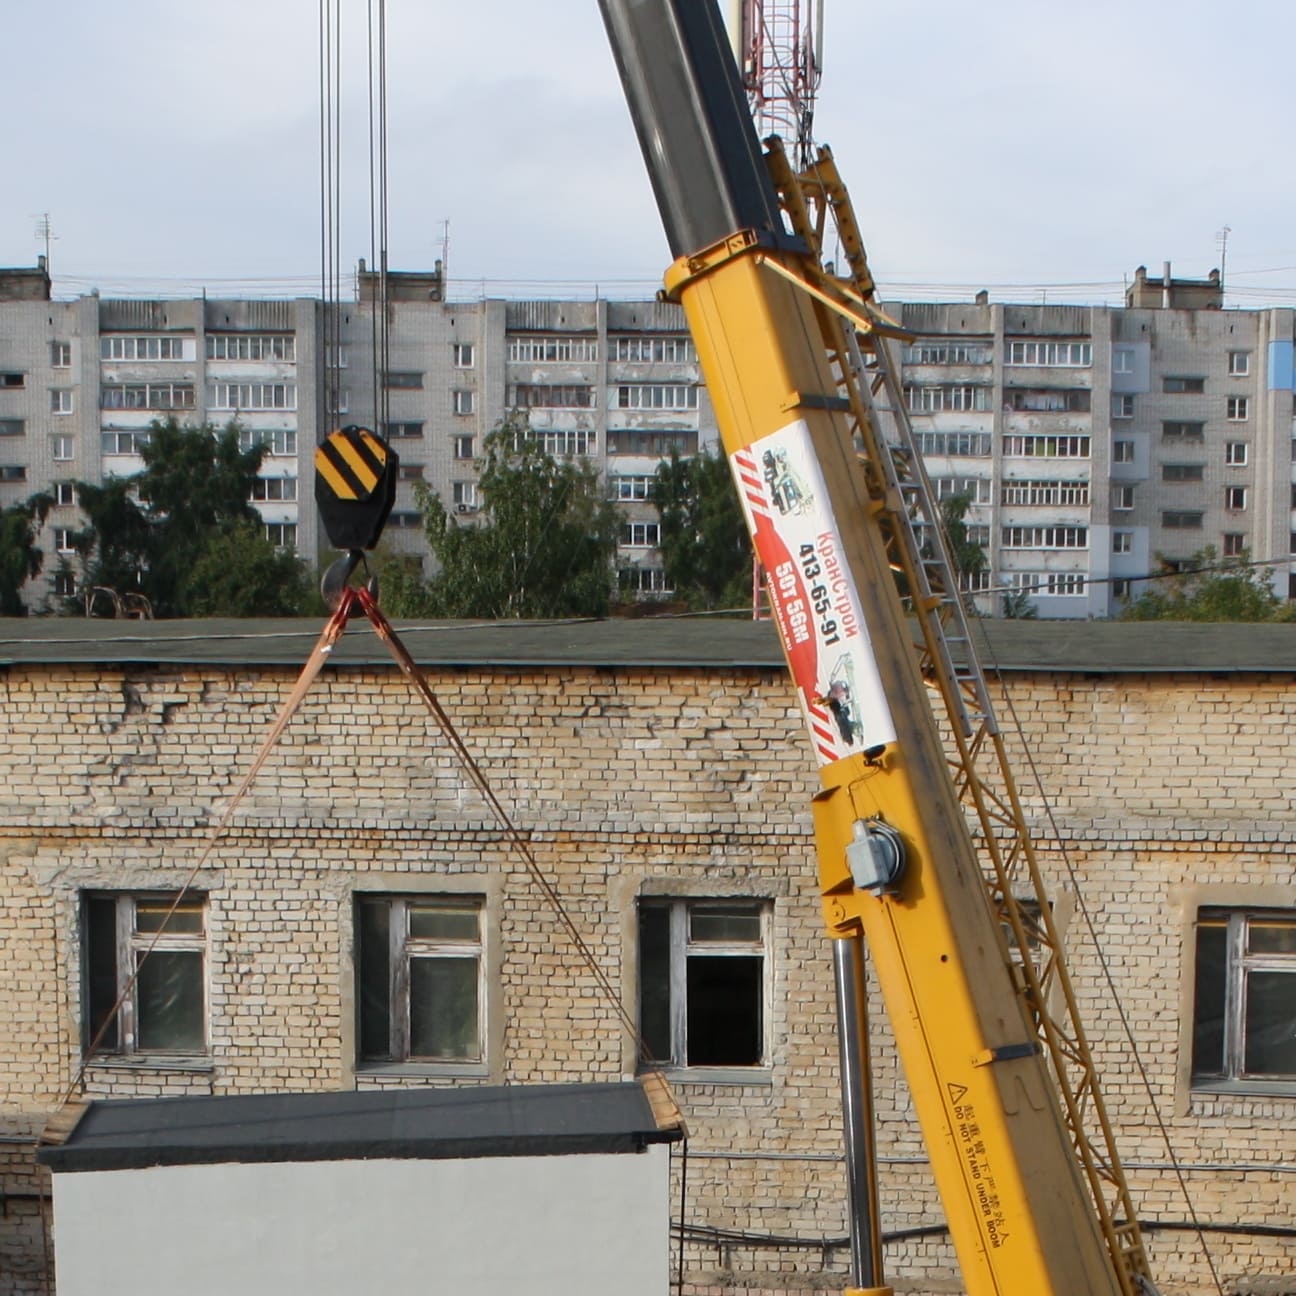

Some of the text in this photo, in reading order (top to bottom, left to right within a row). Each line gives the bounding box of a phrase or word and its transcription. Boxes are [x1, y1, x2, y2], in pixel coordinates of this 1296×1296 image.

[799, 544, 841, 646] 413-65-91
[817, 532, 858, 638] КранСтрой
[954, 1106, 1000, 1249] DO NOT STAND UNDER BOOM
